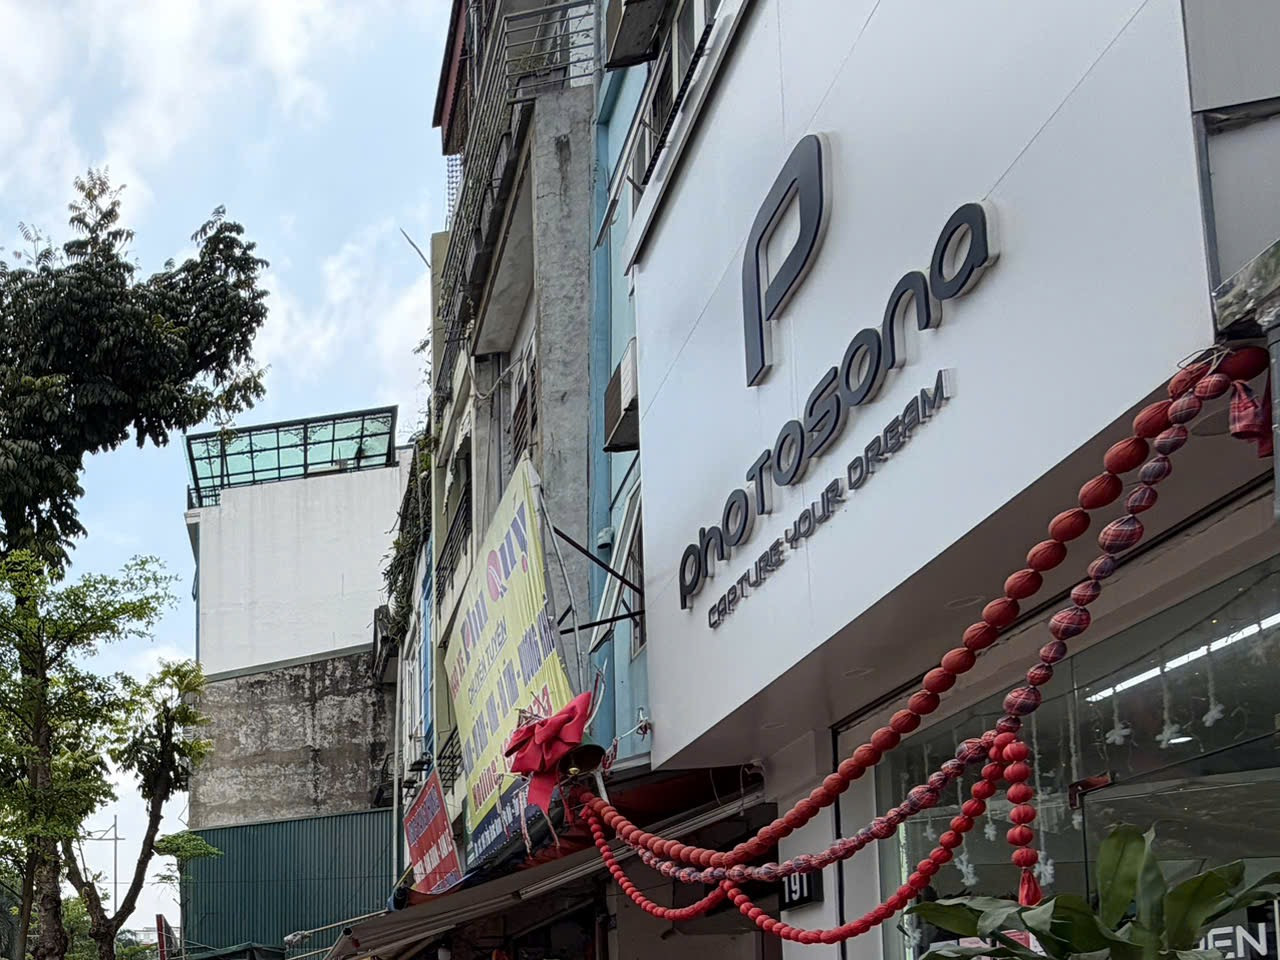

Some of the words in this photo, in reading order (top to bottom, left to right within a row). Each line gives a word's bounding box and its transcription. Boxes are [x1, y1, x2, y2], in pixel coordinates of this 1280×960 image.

[708, 536, 784, 628] CAPTURE
[784, 478, 846, 549] YOUR
[847, 368, 953, 490] DREAM
[782, 872, 808, 903] 191
